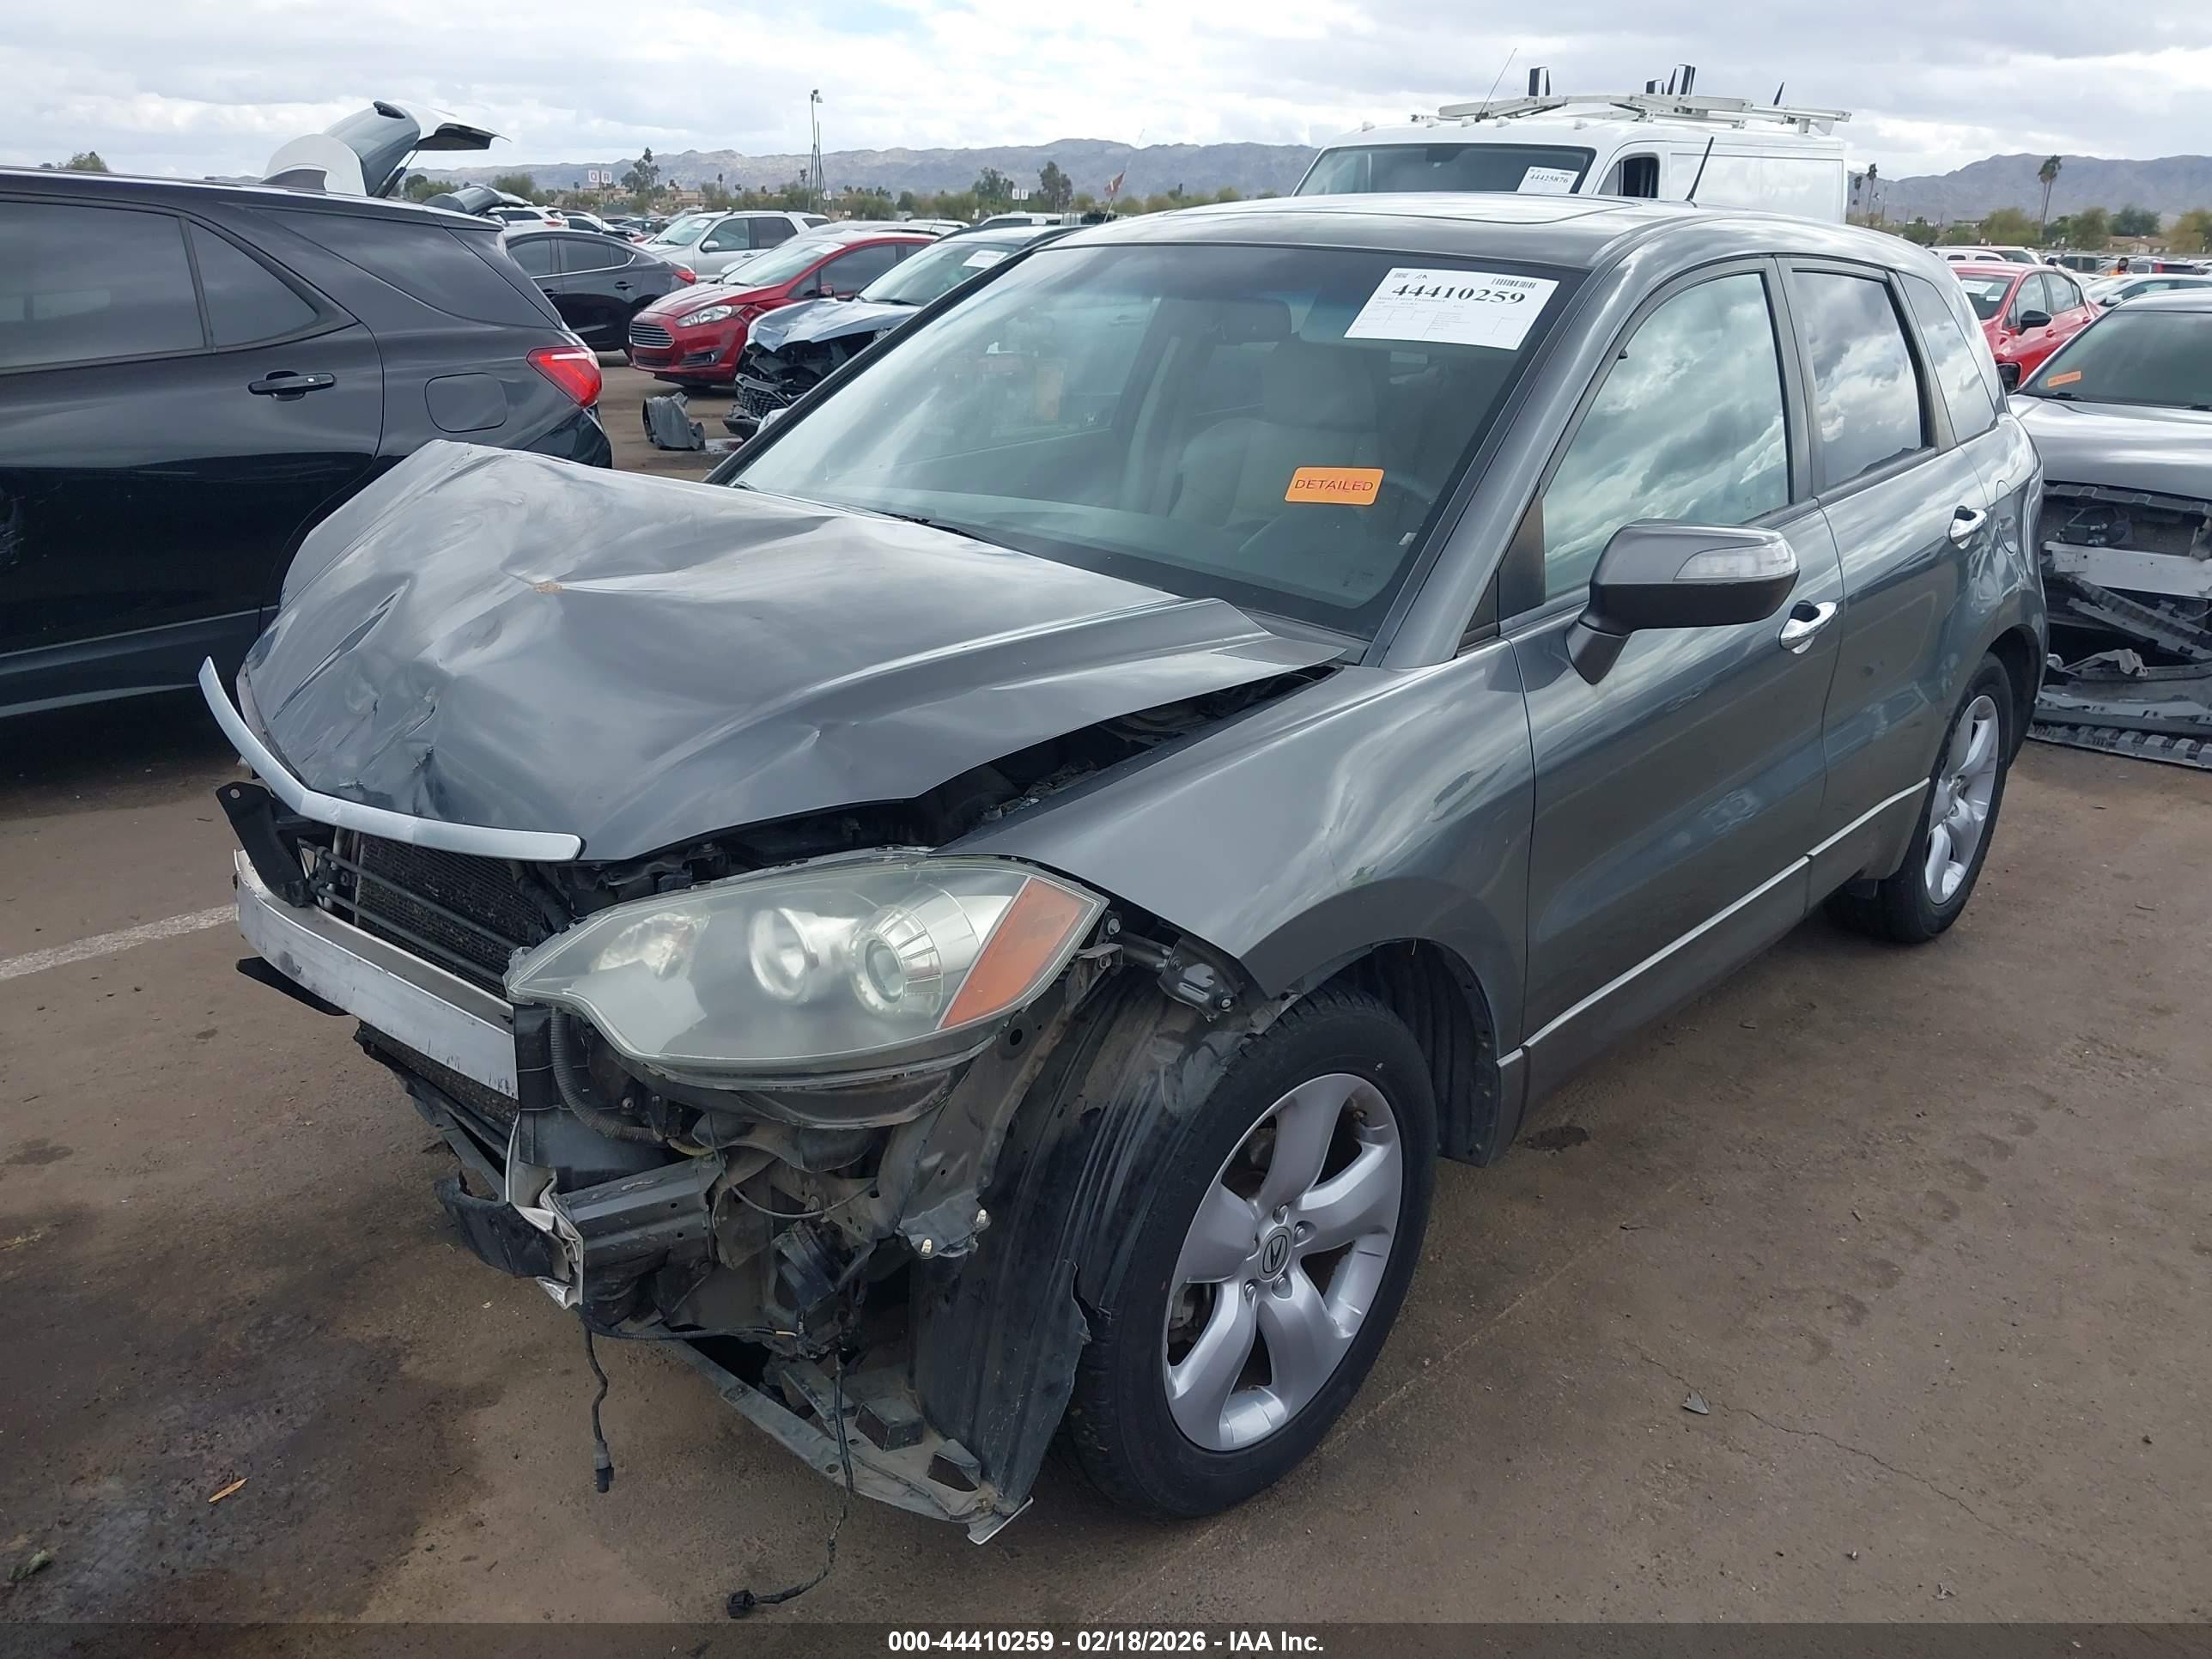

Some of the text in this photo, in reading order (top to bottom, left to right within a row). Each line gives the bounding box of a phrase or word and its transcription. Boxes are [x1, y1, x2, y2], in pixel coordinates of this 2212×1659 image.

[604, 173, 610, 182] R
[1392, 283, 1525, 305] 44410259
[1295, 479, 1374, 491] DETAILED
